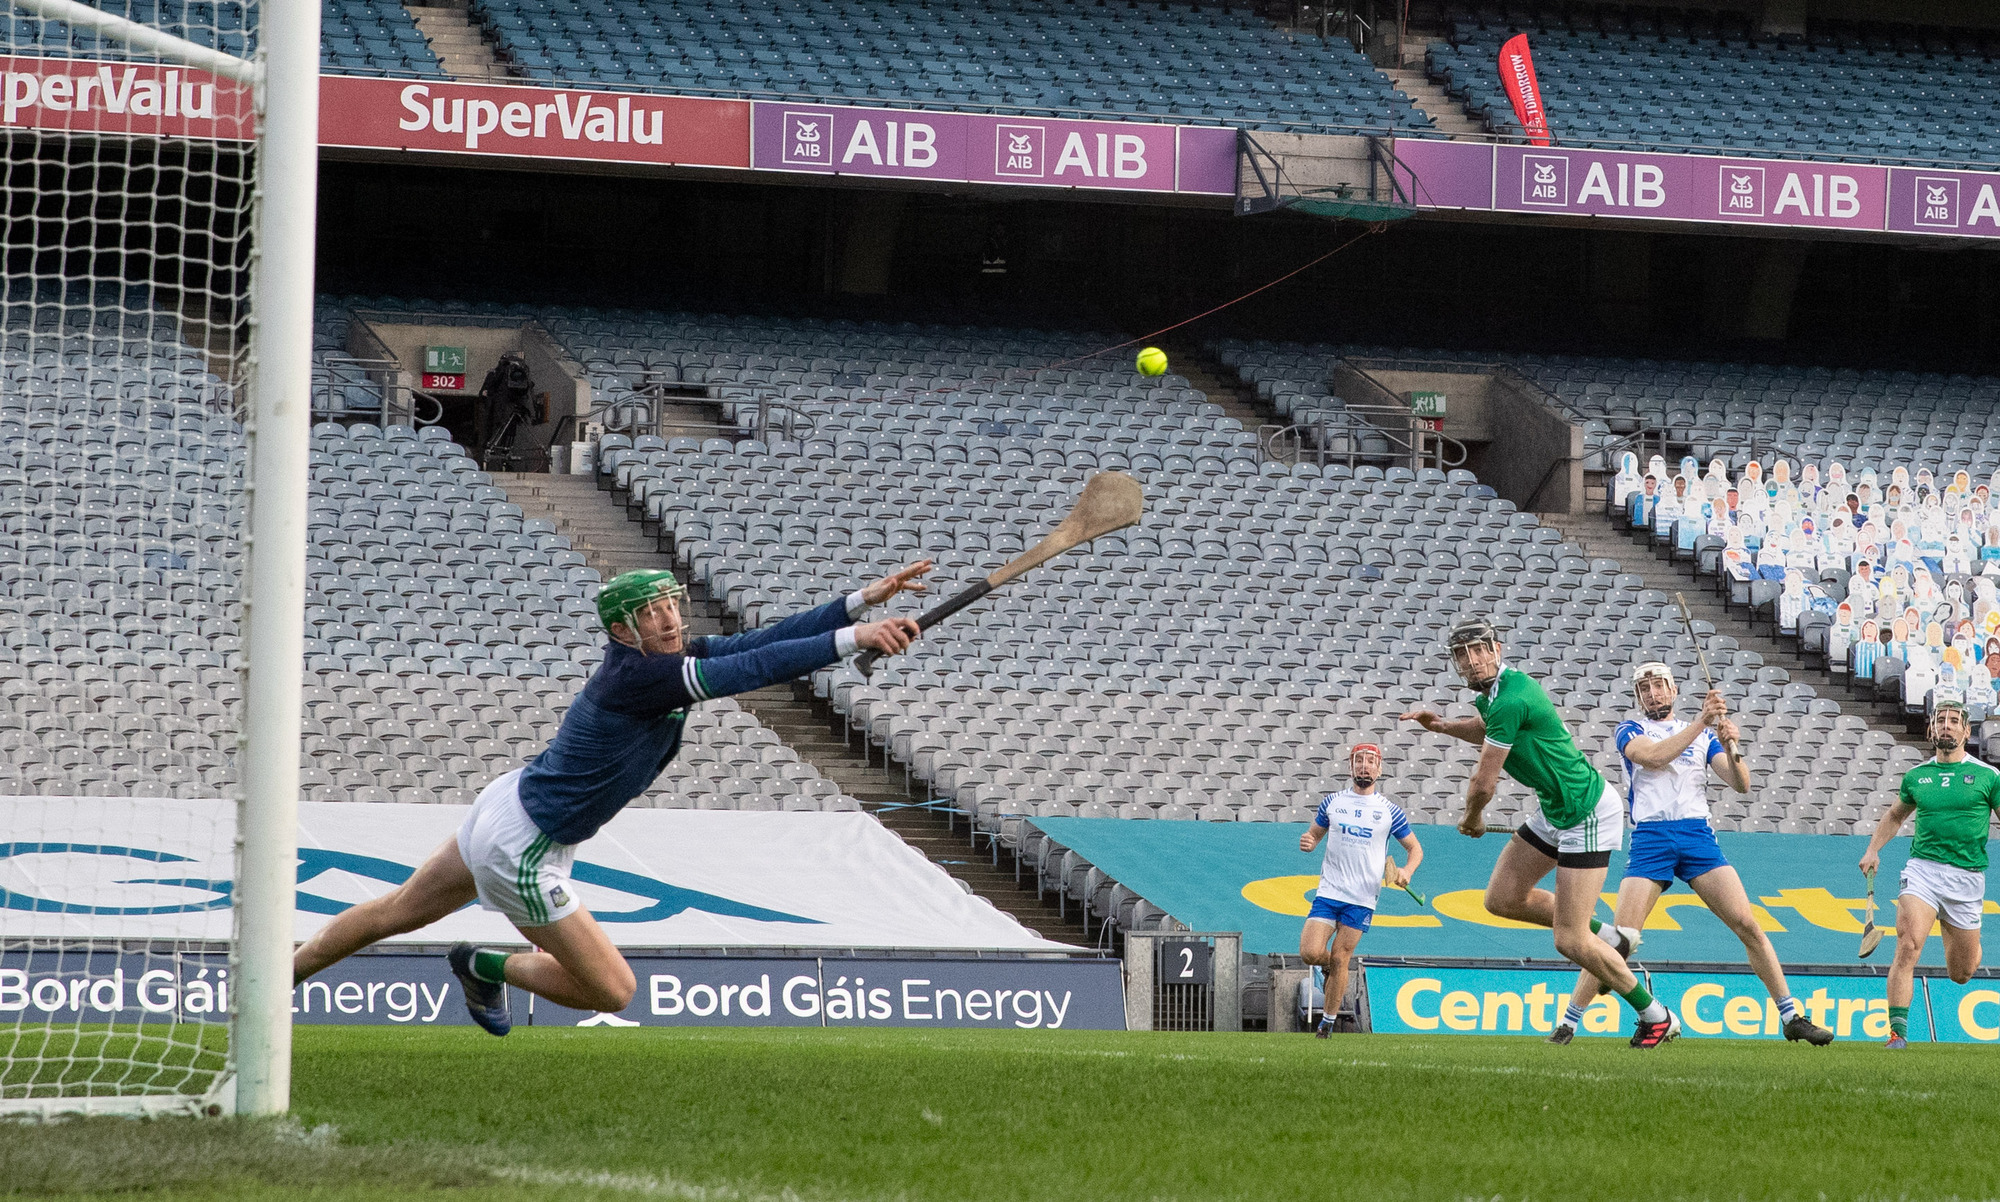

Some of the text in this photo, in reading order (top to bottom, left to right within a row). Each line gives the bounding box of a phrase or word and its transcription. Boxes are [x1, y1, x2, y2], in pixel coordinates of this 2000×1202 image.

[0, 66, 213, 123] perValu
[1510, 54, 1539, 116] TOMORROW
[399, 84, 663, 149] SuperValu
[794, 142, 821, 157] AIB
[842, 119, 938, 168] AIB
[1053, 131, 1147, 179] AIB
[1006, 155, 1033, 169] AIB
[1531, 184, 1557, 198] AIB
[1576, 161, 1666, 208] AIB
[1773, 172, 1861, 219] AIB
[1729, 195, 1754, 209] AIB
[1924, 206, 1949, 220] AIB
[432, 375, 455, 388] 302
[1941, 777, 1950, 787] 2
[1354, 809, 1362, 818] 15
[1338, 822, 1373, 838] TQS
[1179, 947, 1194, 978] 2
[0, 967, 450, 1023] Bord Gái nergy
[649, 974, 1072, 1029] Bord Gáis Energy
